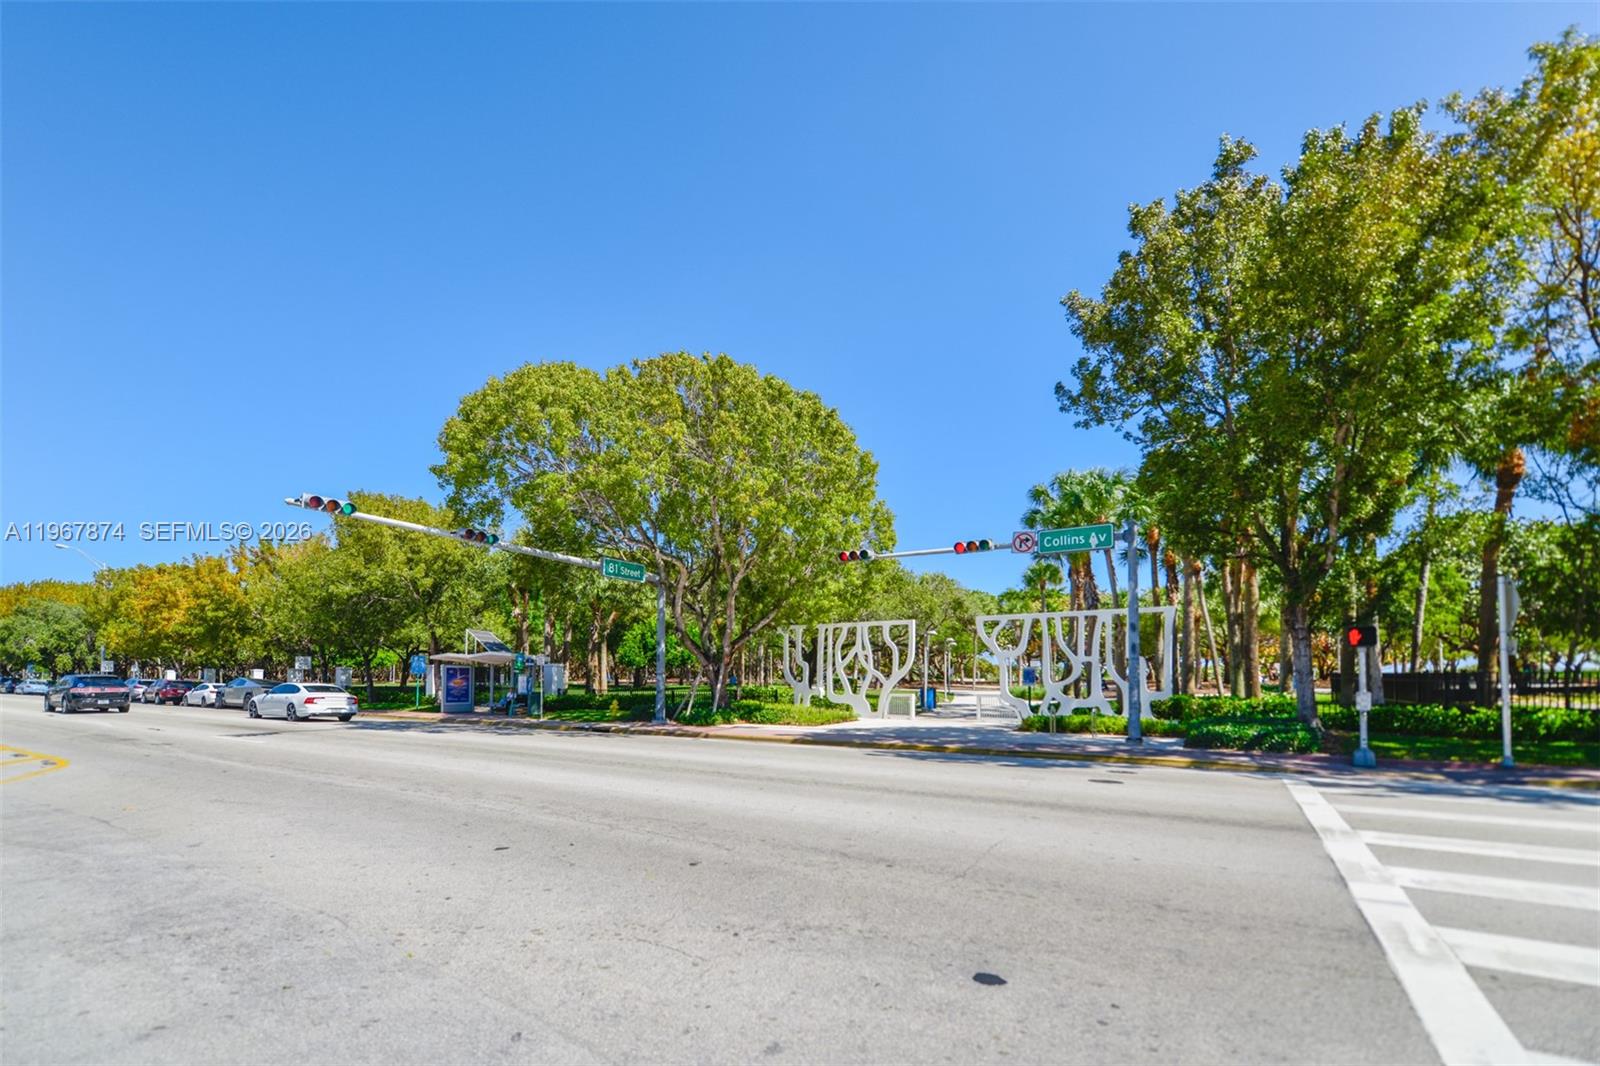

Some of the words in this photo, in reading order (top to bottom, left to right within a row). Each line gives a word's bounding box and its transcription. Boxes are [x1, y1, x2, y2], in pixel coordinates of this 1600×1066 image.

[1043, 534, 1085, 547] Collins
[608, 562, 618, 574] 81
[620, 566, 641, 578] Street
